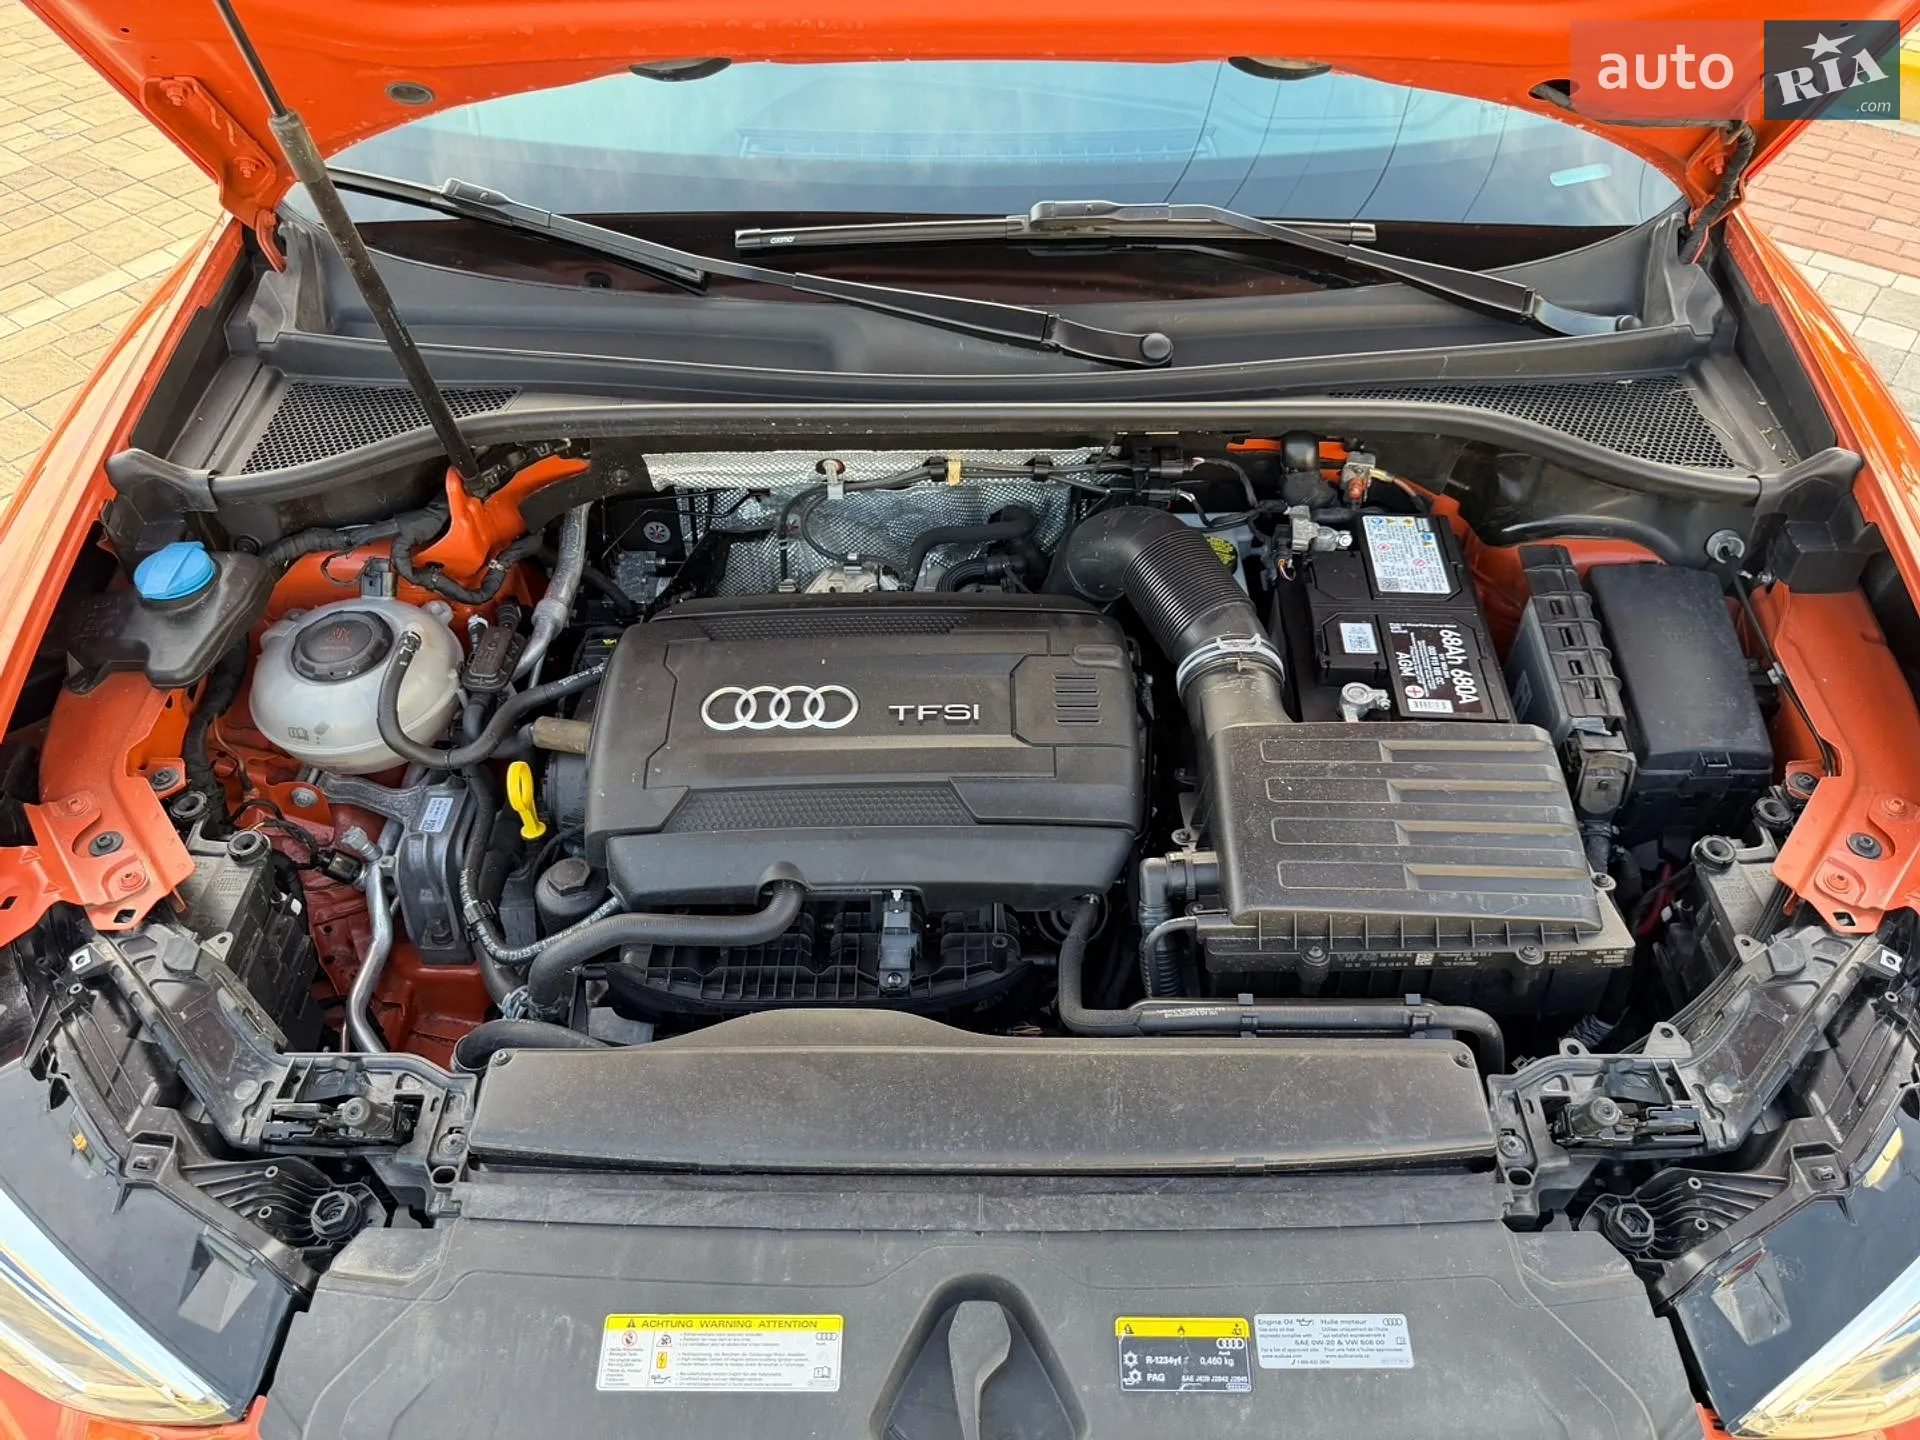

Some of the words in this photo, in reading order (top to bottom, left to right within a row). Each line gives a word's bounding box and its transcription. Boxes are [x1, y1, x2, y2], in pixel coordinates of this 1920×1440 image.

[1440, 629, 1468, 665] 68Ah
[1395, 651, 1416, 676] AGM
[1450, 668, 1480, 704] 680A
[888, 704, 980, 721] TFSI
[641, 1320, 694, 1328] ACHTUNG
[699, 1320, 754, 1328] WARNING
[758, 1320, 818, 1329] ATTENTION
[1224, 1356, 1234, 1367] kg
[1146, 1373, 1166, 1382] PAG
